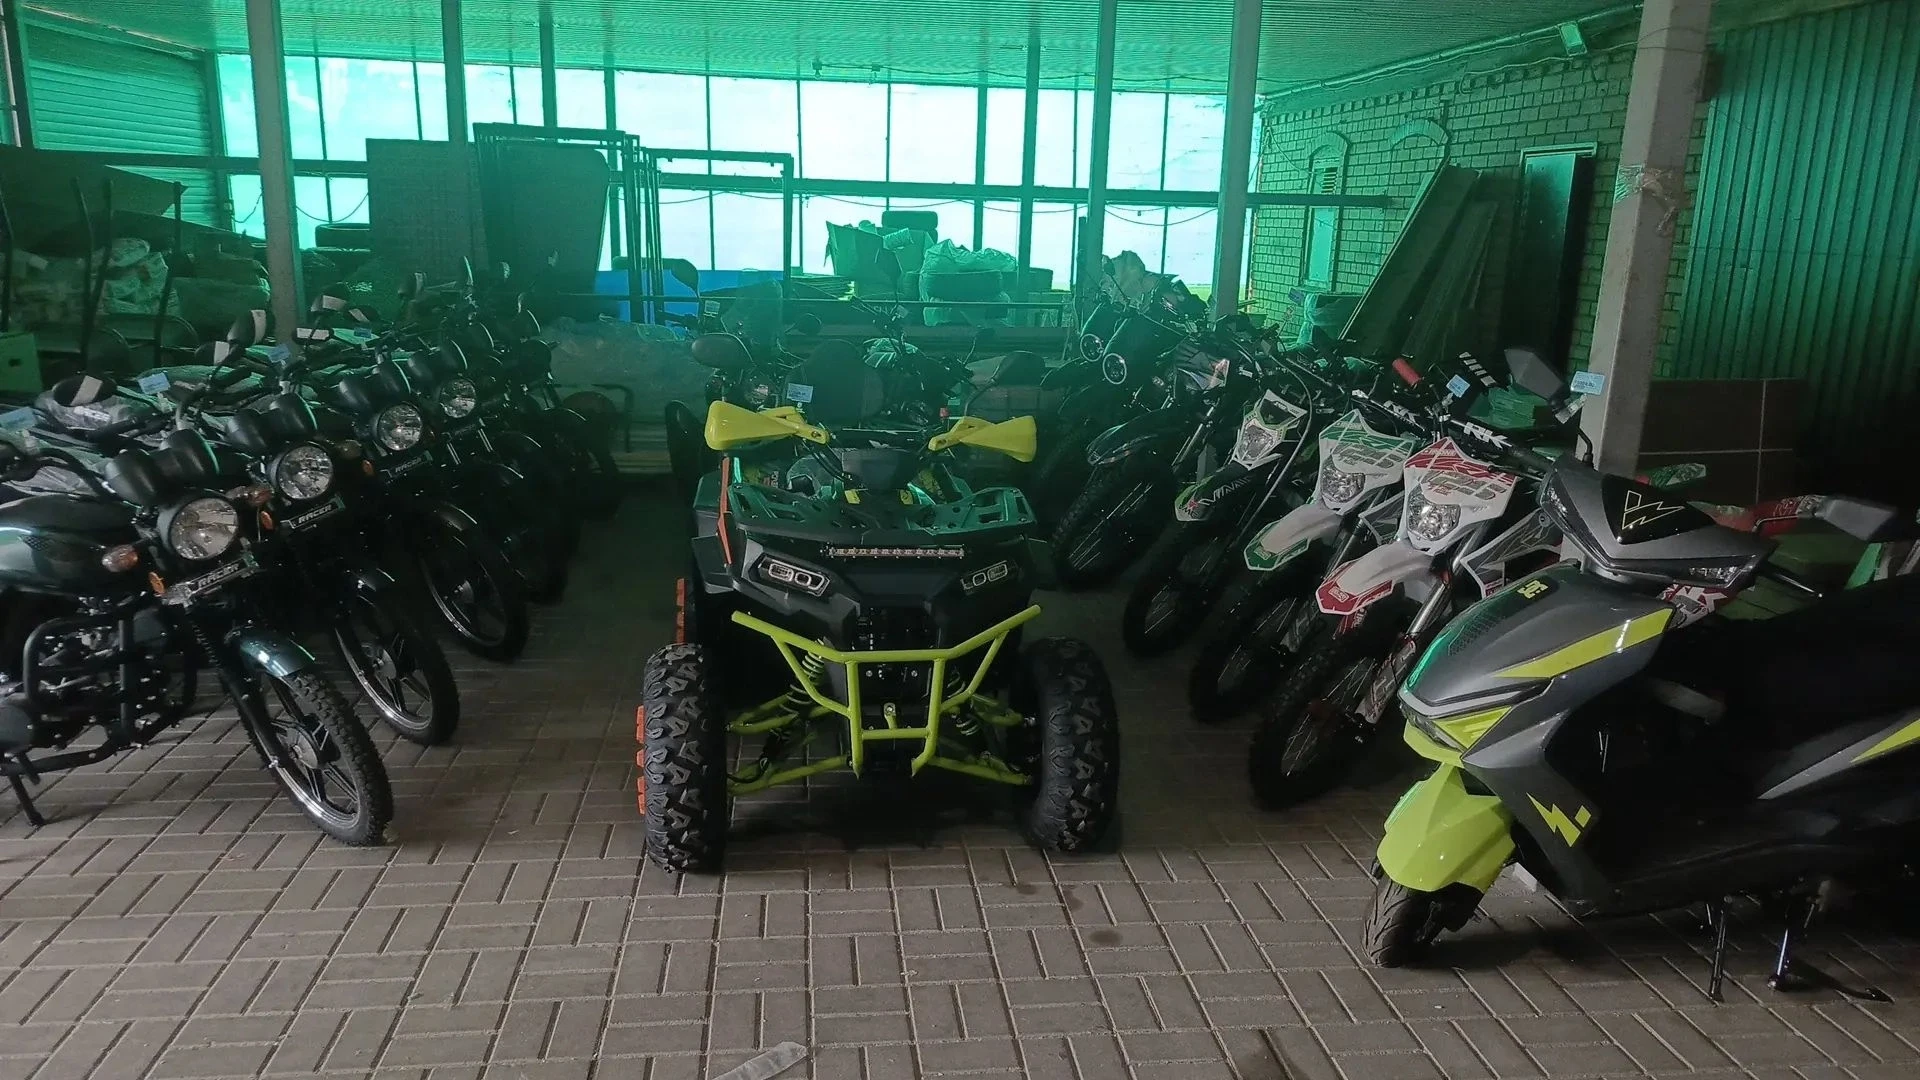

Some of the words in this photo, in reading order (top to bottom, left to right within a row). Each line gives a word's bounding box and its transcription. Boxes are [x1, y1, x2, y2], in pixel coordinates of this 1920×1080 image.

[1463, 421, 1508, 449] RK
[297, 503, 333, 524] RACER
[197, 563, 241, 587] RACER
